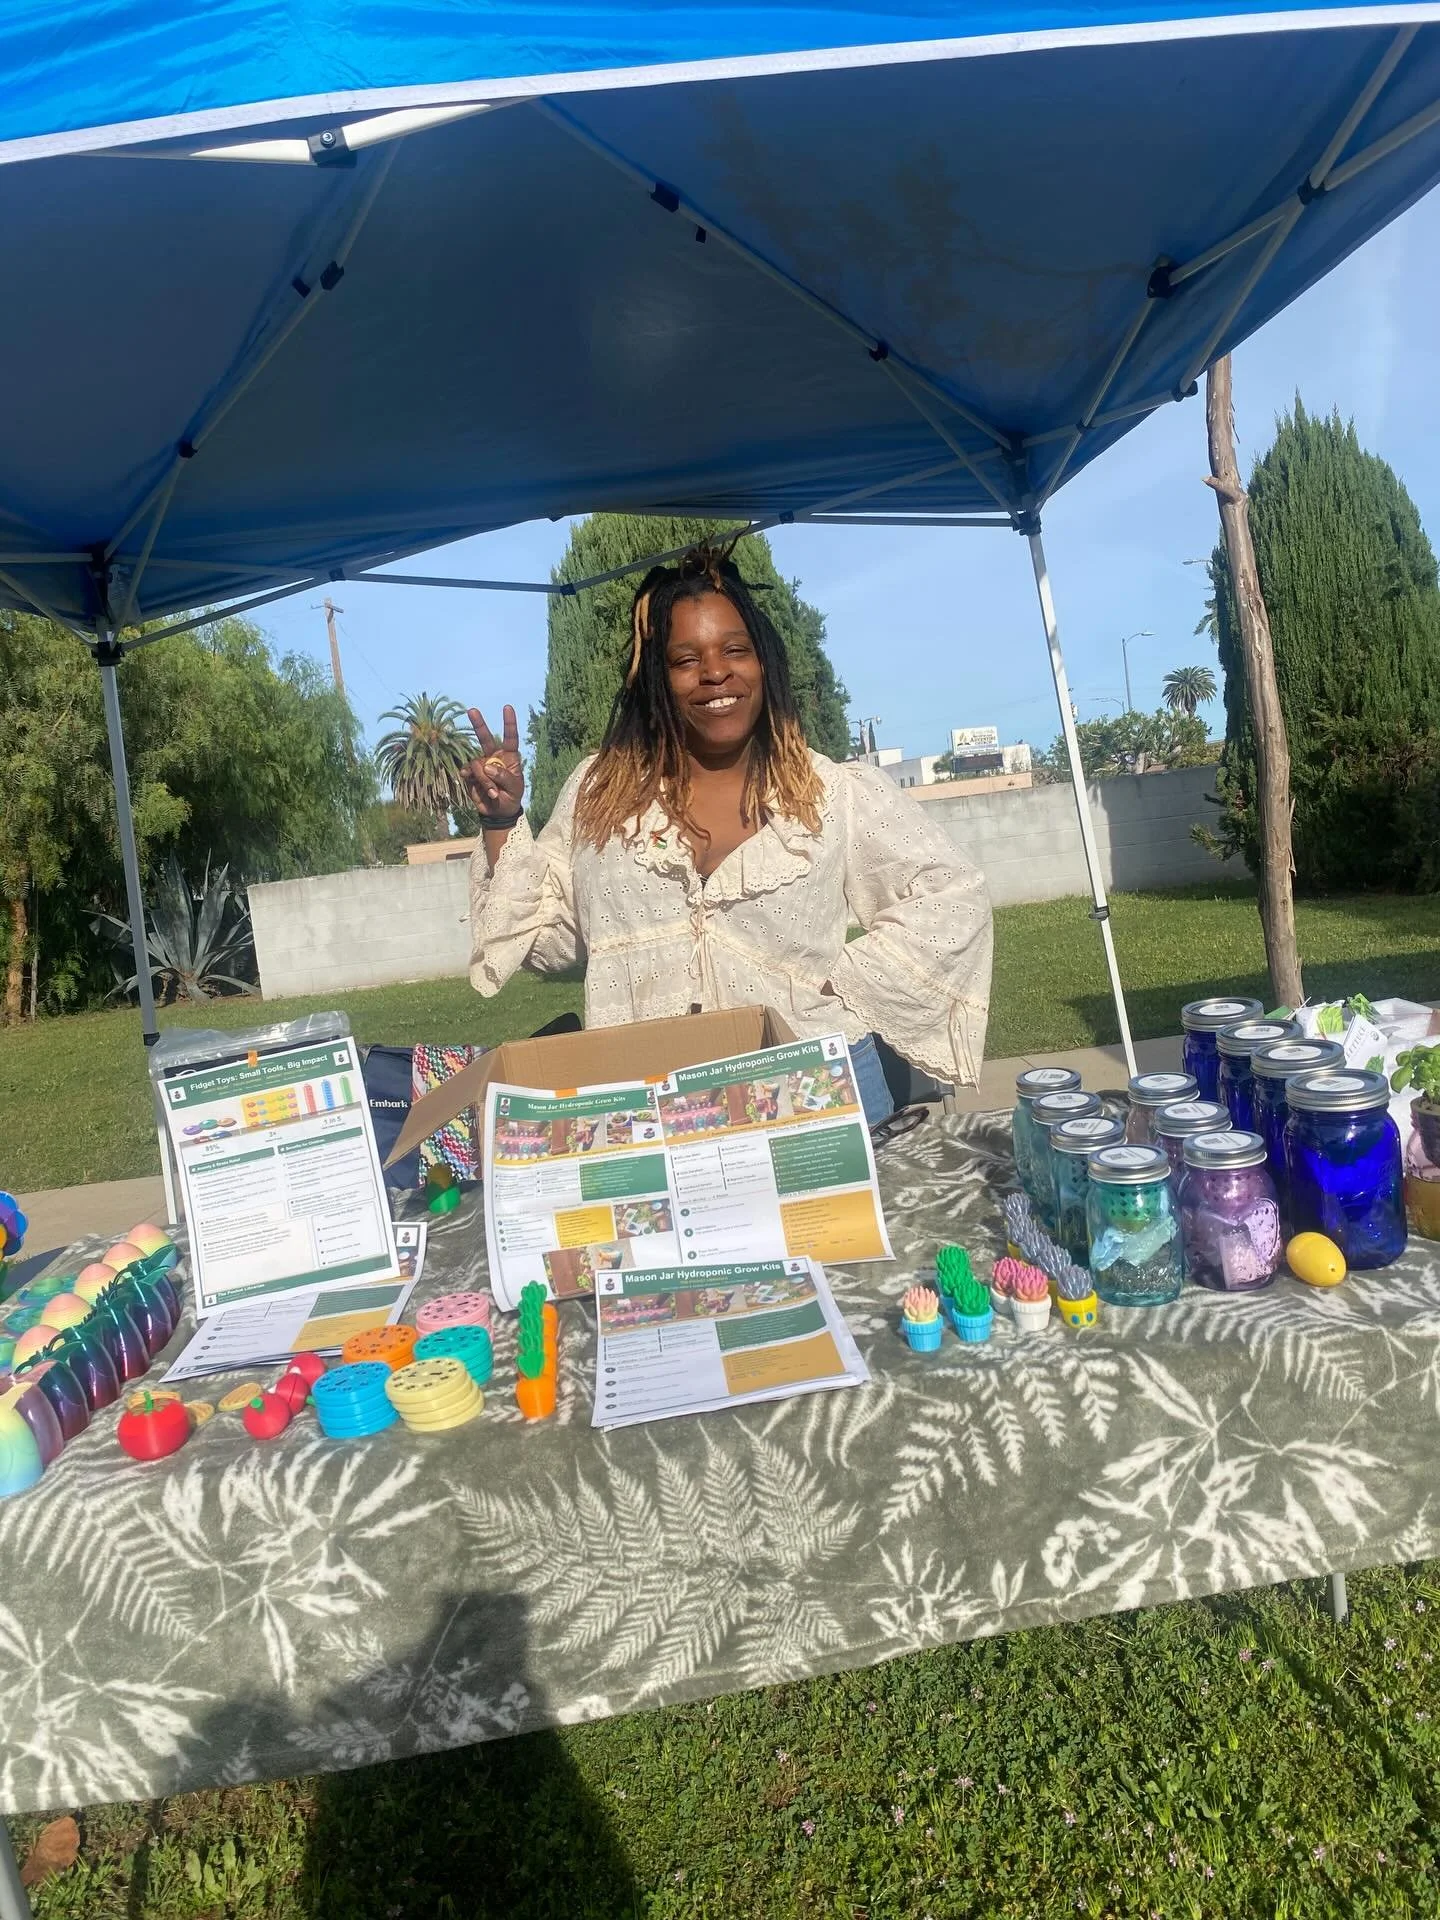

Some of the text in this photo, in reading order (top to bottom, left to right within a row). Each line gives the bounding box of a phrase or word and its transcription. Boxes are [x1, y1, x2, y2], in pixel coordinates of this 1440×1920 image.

[190, 1080, 215, 1091] Fidget
[216, 1075, 238, 1085] Toys:
[239, 1069, 261, 1079] Small
[287, 1059, 301, 1069] Big
[302, 1055, 328, 1067] Impact
[678, 1070, 707, 1081] Mason
[709, 1067, 723, 1075] Jar
[724, 1056, 775, 1074] Hydroponic
[776, 1050, 800, 1061] Grow
[801, 1045, 820, 1055] Kits
[370, 1099, 408, 1108] Embark
[548, 1102, 558, 1110] Jar
[559, 1099, 594, 1110] Hydroponic
[625, 1273, 657, 1283] Mason
[659, 1271, 674, 1280] Jar
[677, 1267, 732, 1281] Hydroponic
[734, 1265, 760, 1274] Grow
[762, 1263, 781, 1271] Kits
